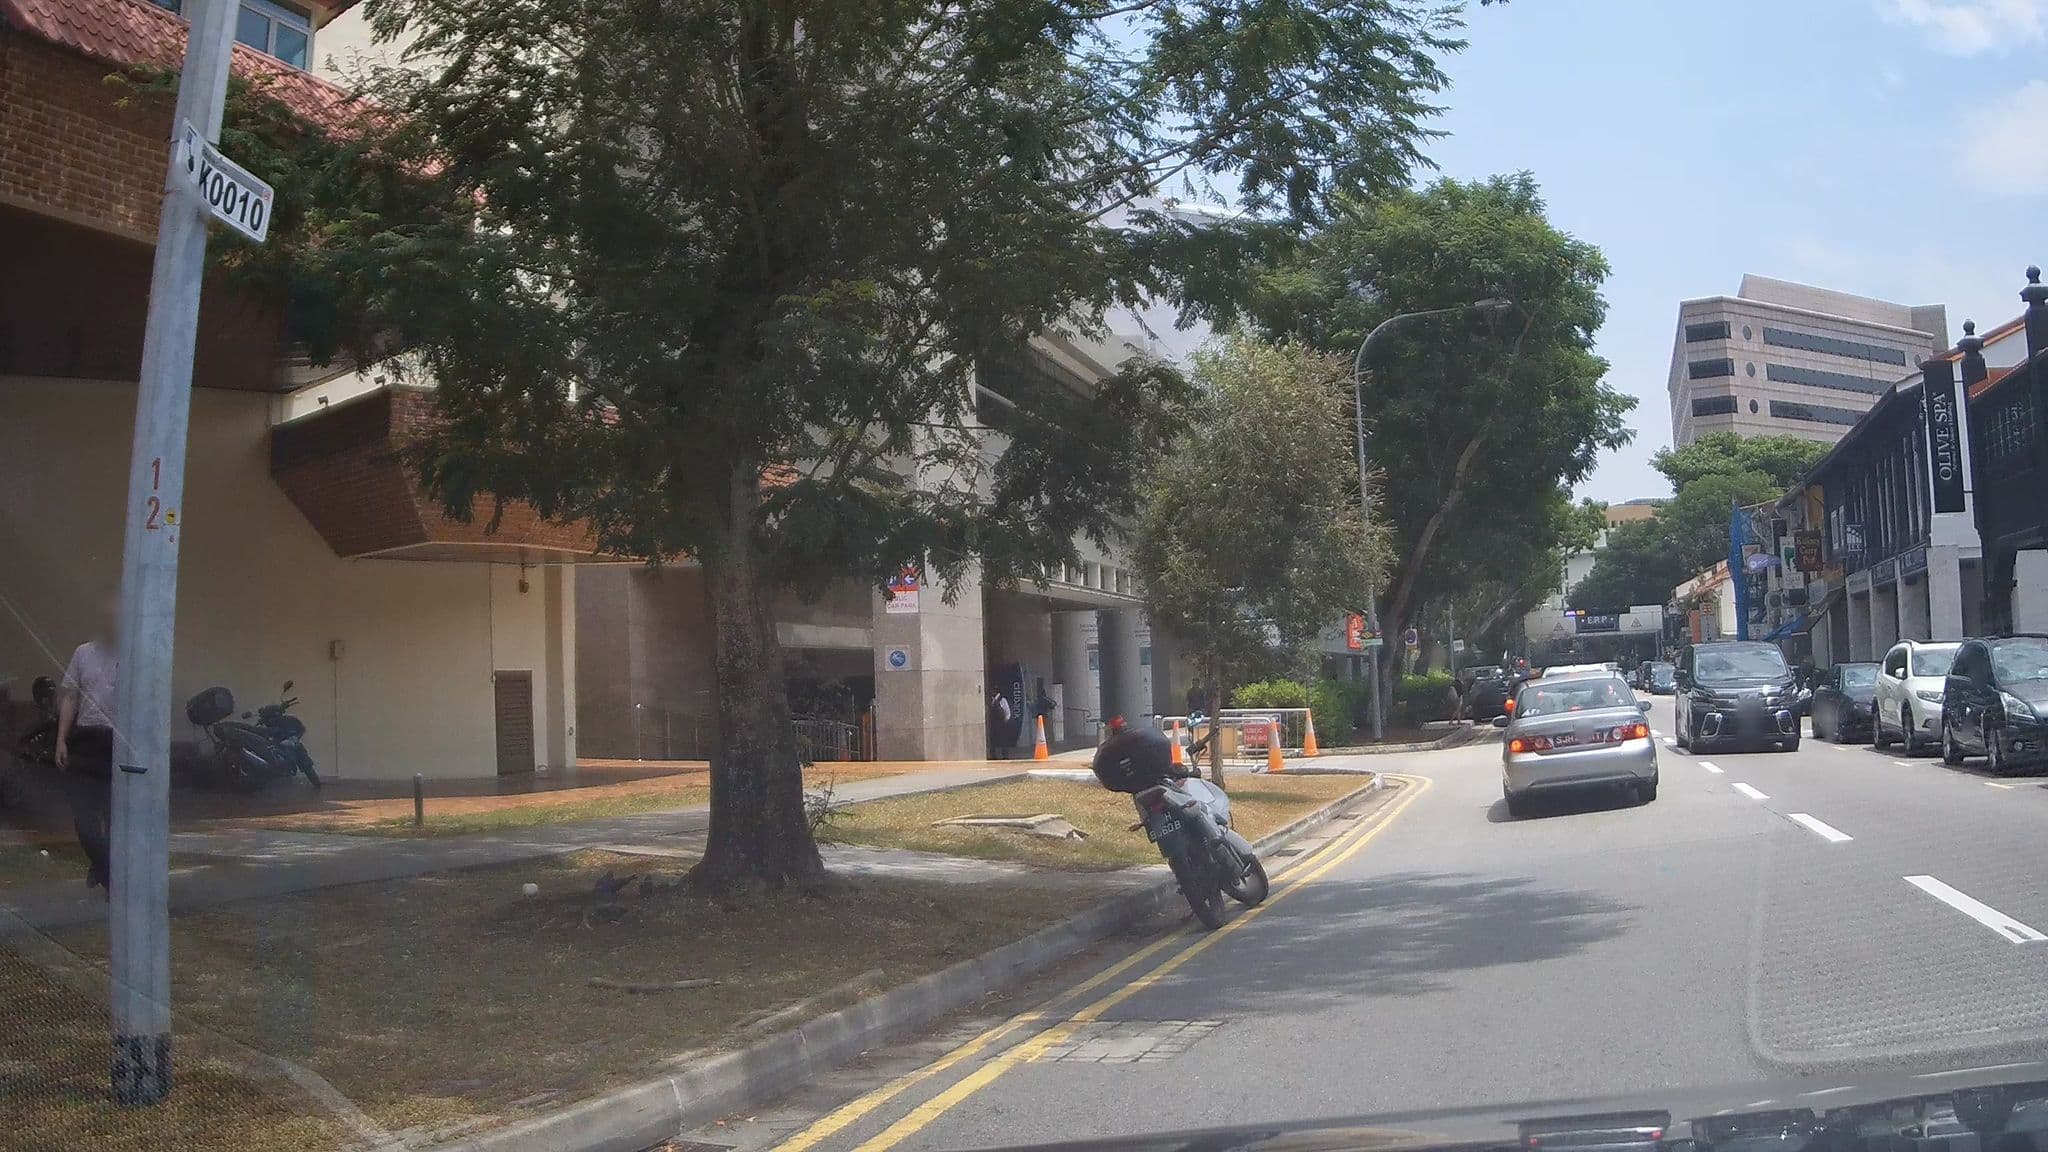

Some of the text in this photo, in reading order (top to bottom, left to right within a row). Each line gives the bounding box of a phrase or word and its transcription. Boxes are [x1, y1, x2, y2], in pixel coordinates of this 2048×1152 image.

[199, 159, 264, 231] K0010
[1932, 393, 1953, 480] OLIVE SPA
[1587, 615, 1608, 625] ERP
[1013, 681, 1022, 719] citibank
